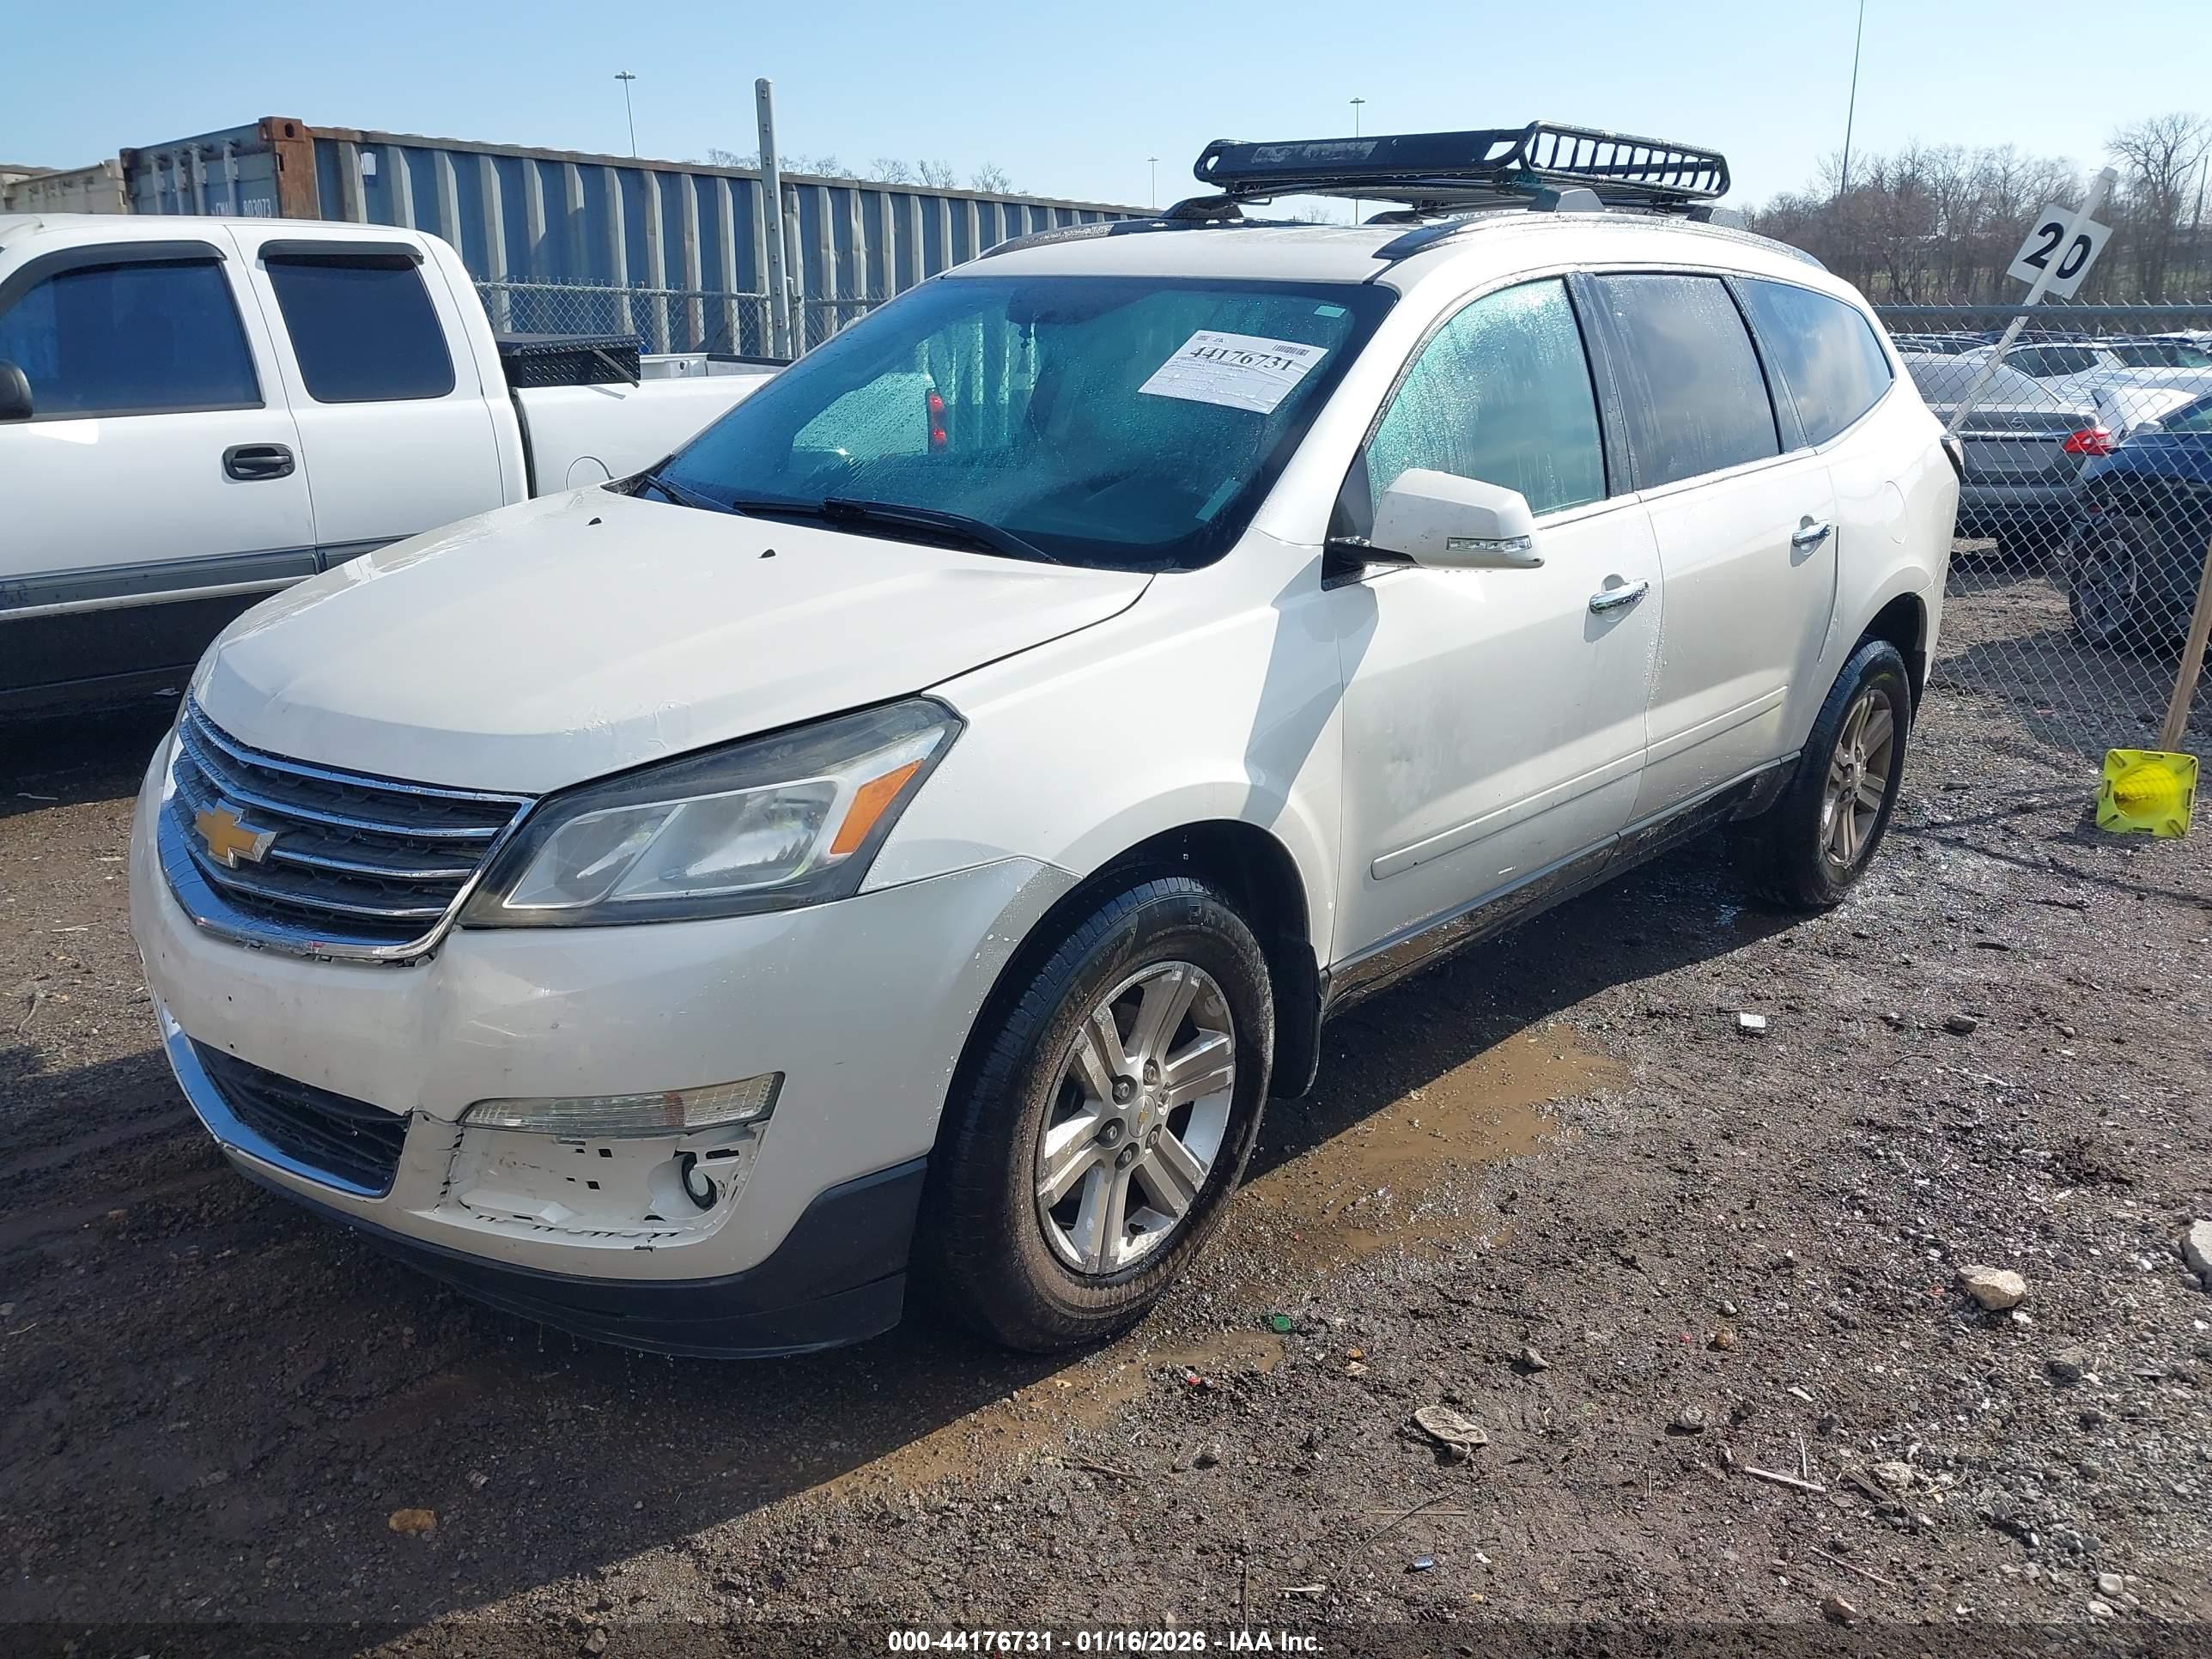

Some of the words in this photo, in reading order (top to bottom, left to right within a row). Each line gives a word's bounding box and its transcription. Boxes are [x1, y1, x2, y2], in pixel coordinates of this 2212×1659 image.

[243, 198, 272, 218] 803073
[2022, 222, 2093, 280] 20
[1190, 346, 1295, 371] 44176731
